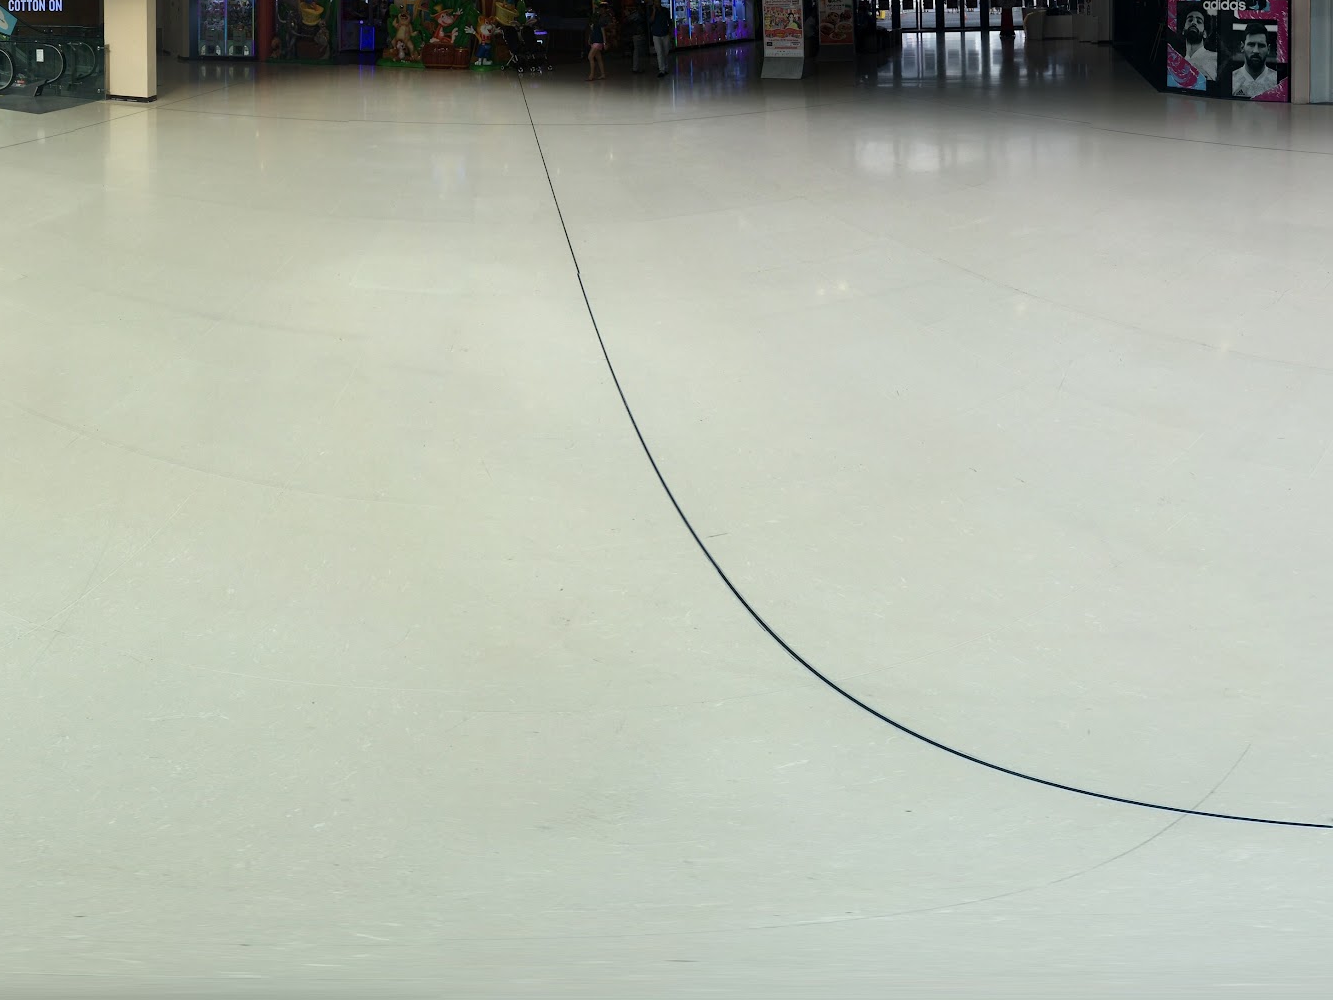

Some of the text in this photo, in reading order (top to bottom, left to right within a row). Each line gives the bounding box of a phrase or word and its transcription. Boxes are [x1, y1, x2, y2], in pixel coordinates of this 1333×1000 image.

[8, 0, 46, 12] COTTON
[49, 0, 63, 12] ON
[1203, 0, 1247, 11] adidas
